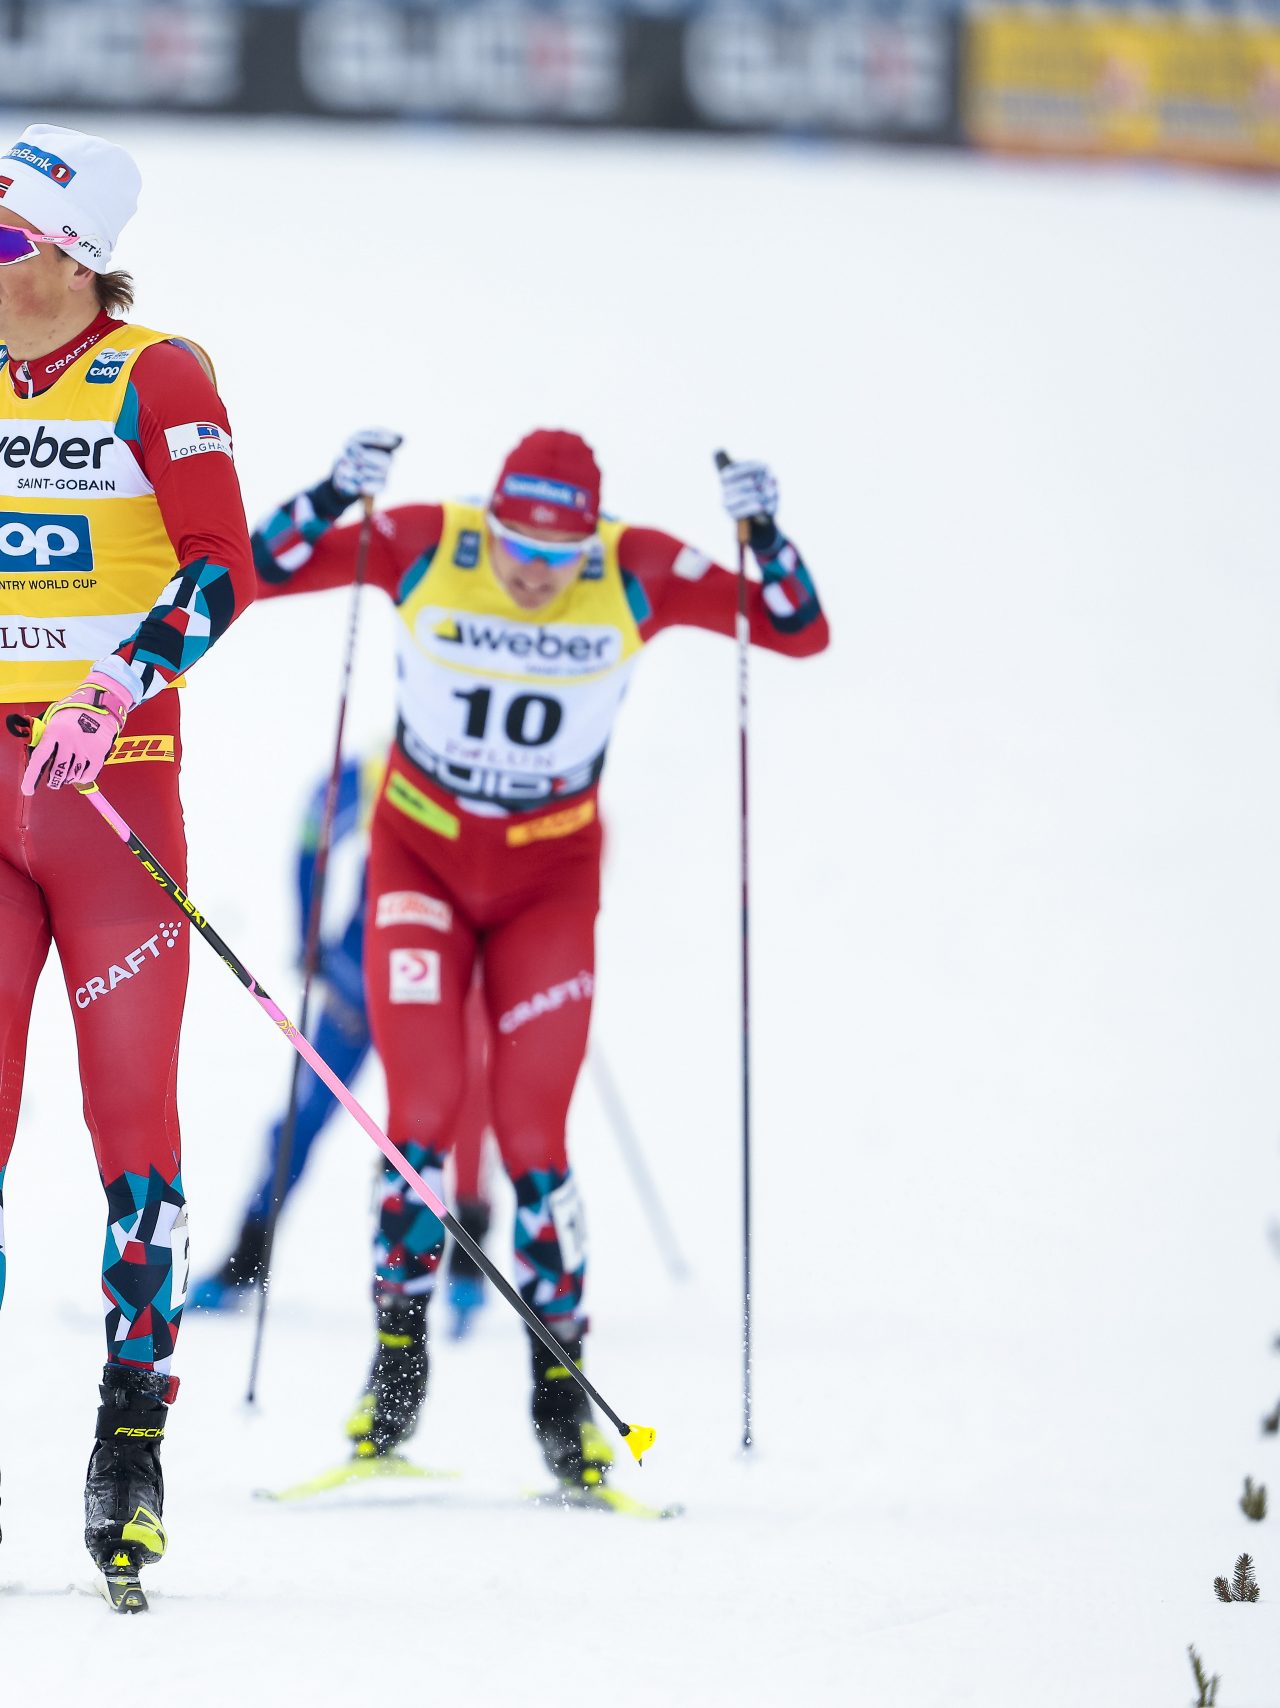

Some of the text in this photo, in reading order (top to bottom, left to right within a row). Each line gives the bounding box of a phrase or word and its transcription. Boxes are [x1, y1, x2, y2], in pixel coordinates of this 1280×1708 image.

[56, 167, 67, 179] 1
[62, 225, 96, 254] CRFT
[45, 341, 89, 374] CRAFT
[17, 478, 115, 491] SAINT-GOBAIN
[29, 580, 69, 590] WORLD
[73, 579, 98, 590] CUP
[470, 625, 612, 662] weber
[453, 684, 563, 748] 10
[108, 740, 166, 760] HL
[173, 888, 207, 929] LEKI
[75, 934, 161, 1009] CRAFT
[114, 1427, 165, 1438] FISCH
